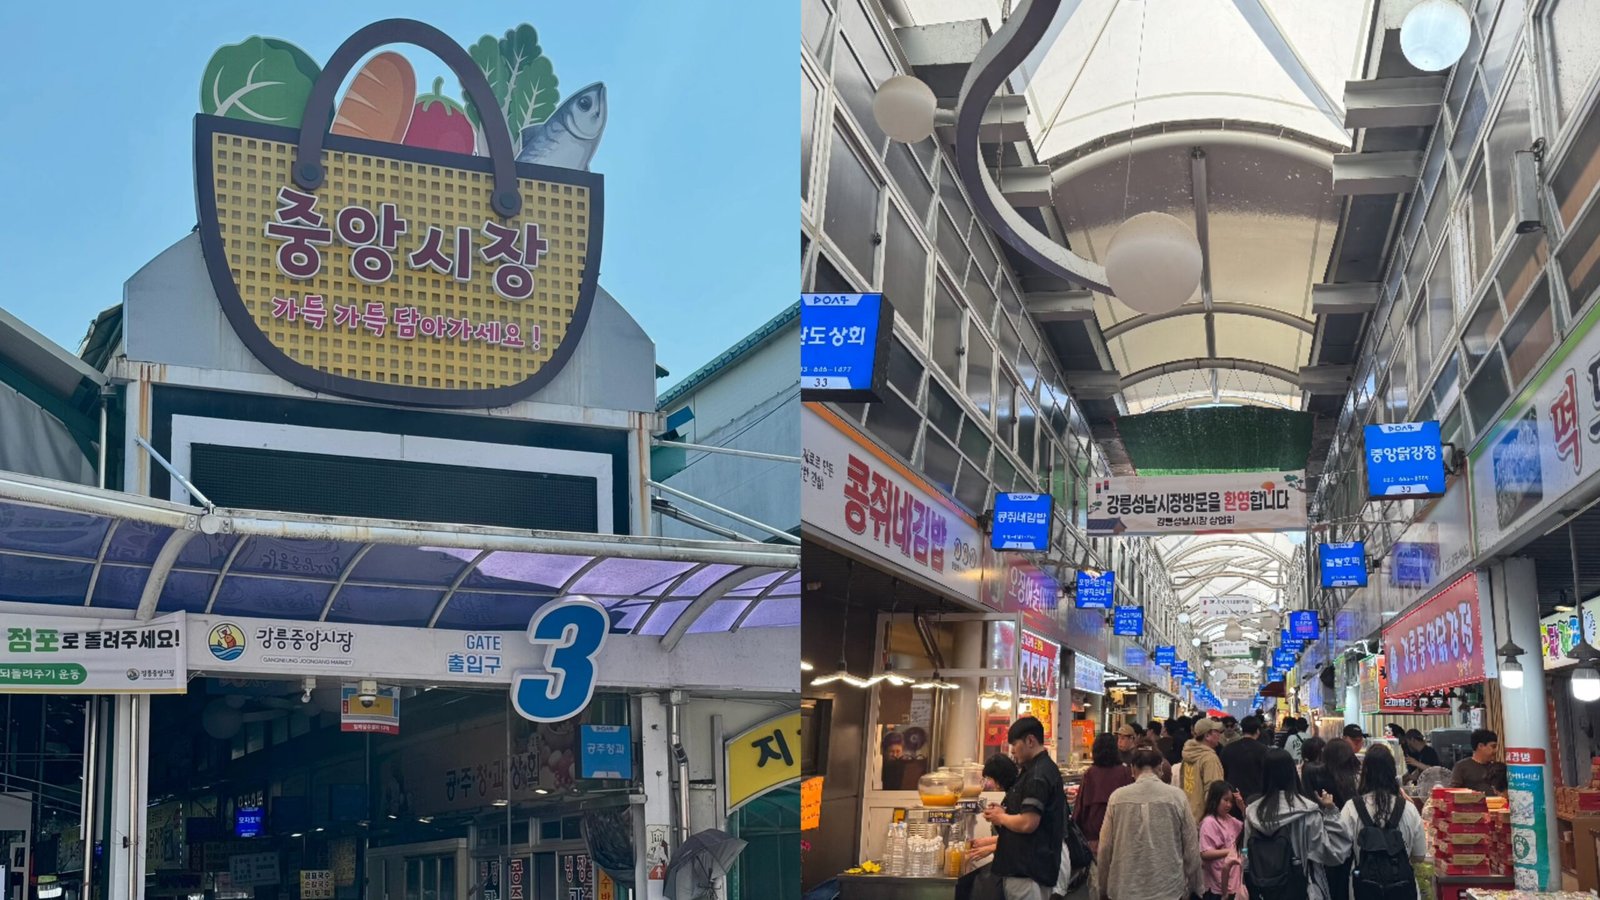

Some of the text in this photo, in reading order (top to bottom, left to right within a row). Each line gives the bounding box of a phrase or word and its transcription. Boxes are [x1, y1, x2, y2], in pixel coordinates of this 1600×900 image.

[266, 187, 548, 298] 중앙시장
[273, 295, 327, 329] 가득
[334, 303, 388, 337] 가득
[814, 378, 828, 388] 33
[1371, 445, 1437, 463] 중앙닭강정
[1107, 488, 1290, 515] 강릉성남시장방문을 환영합니다
[844, 453, 947, 574] 콩쥐네김밥
[998, 511, 1046, 524] 콩쥐네김밥
[8, 627, 180, 653] 점포로 돌려주세요!
[256, 627, 354, 653] 강릉중앙시장
[466, 634, 501, 651] GATE
[299, 657, 331, 665] JOONGANG
[448, 654, 501, 675] 출입구
[515, 602, 608, 719] 3
[59, 669, 81, 680] 운동
[587, 742, 625, 755] 공주청과
[751, 729, 800, 767] 지
